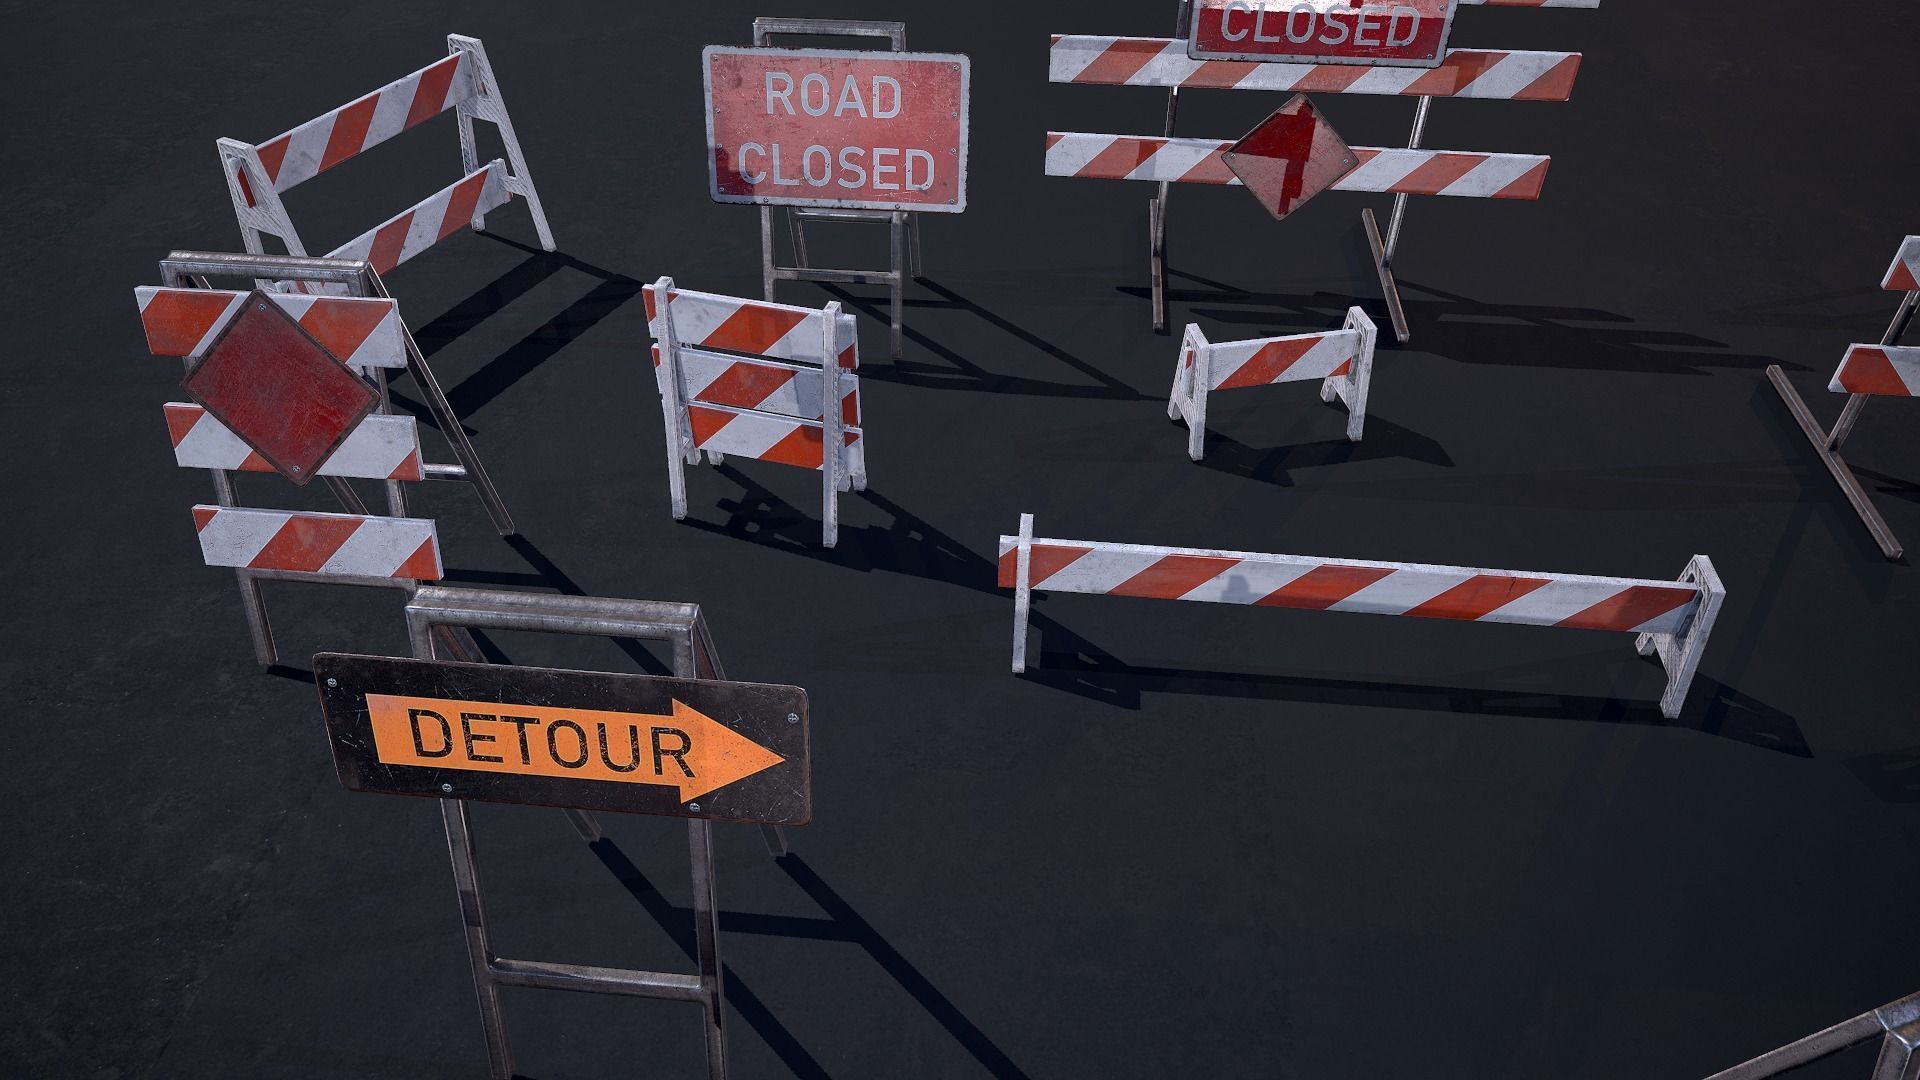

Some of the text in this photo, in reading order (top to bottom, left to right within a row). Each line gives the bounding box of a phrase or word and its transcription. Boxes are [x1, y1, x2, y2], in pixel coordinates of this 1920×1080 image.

[1221, 2, 1420, 47] CLOSED
[765, 71, 901, 119] ROAD
[737, 142, 935, 190] CLOSED
[407, 708, 697, 778] DETOUR
